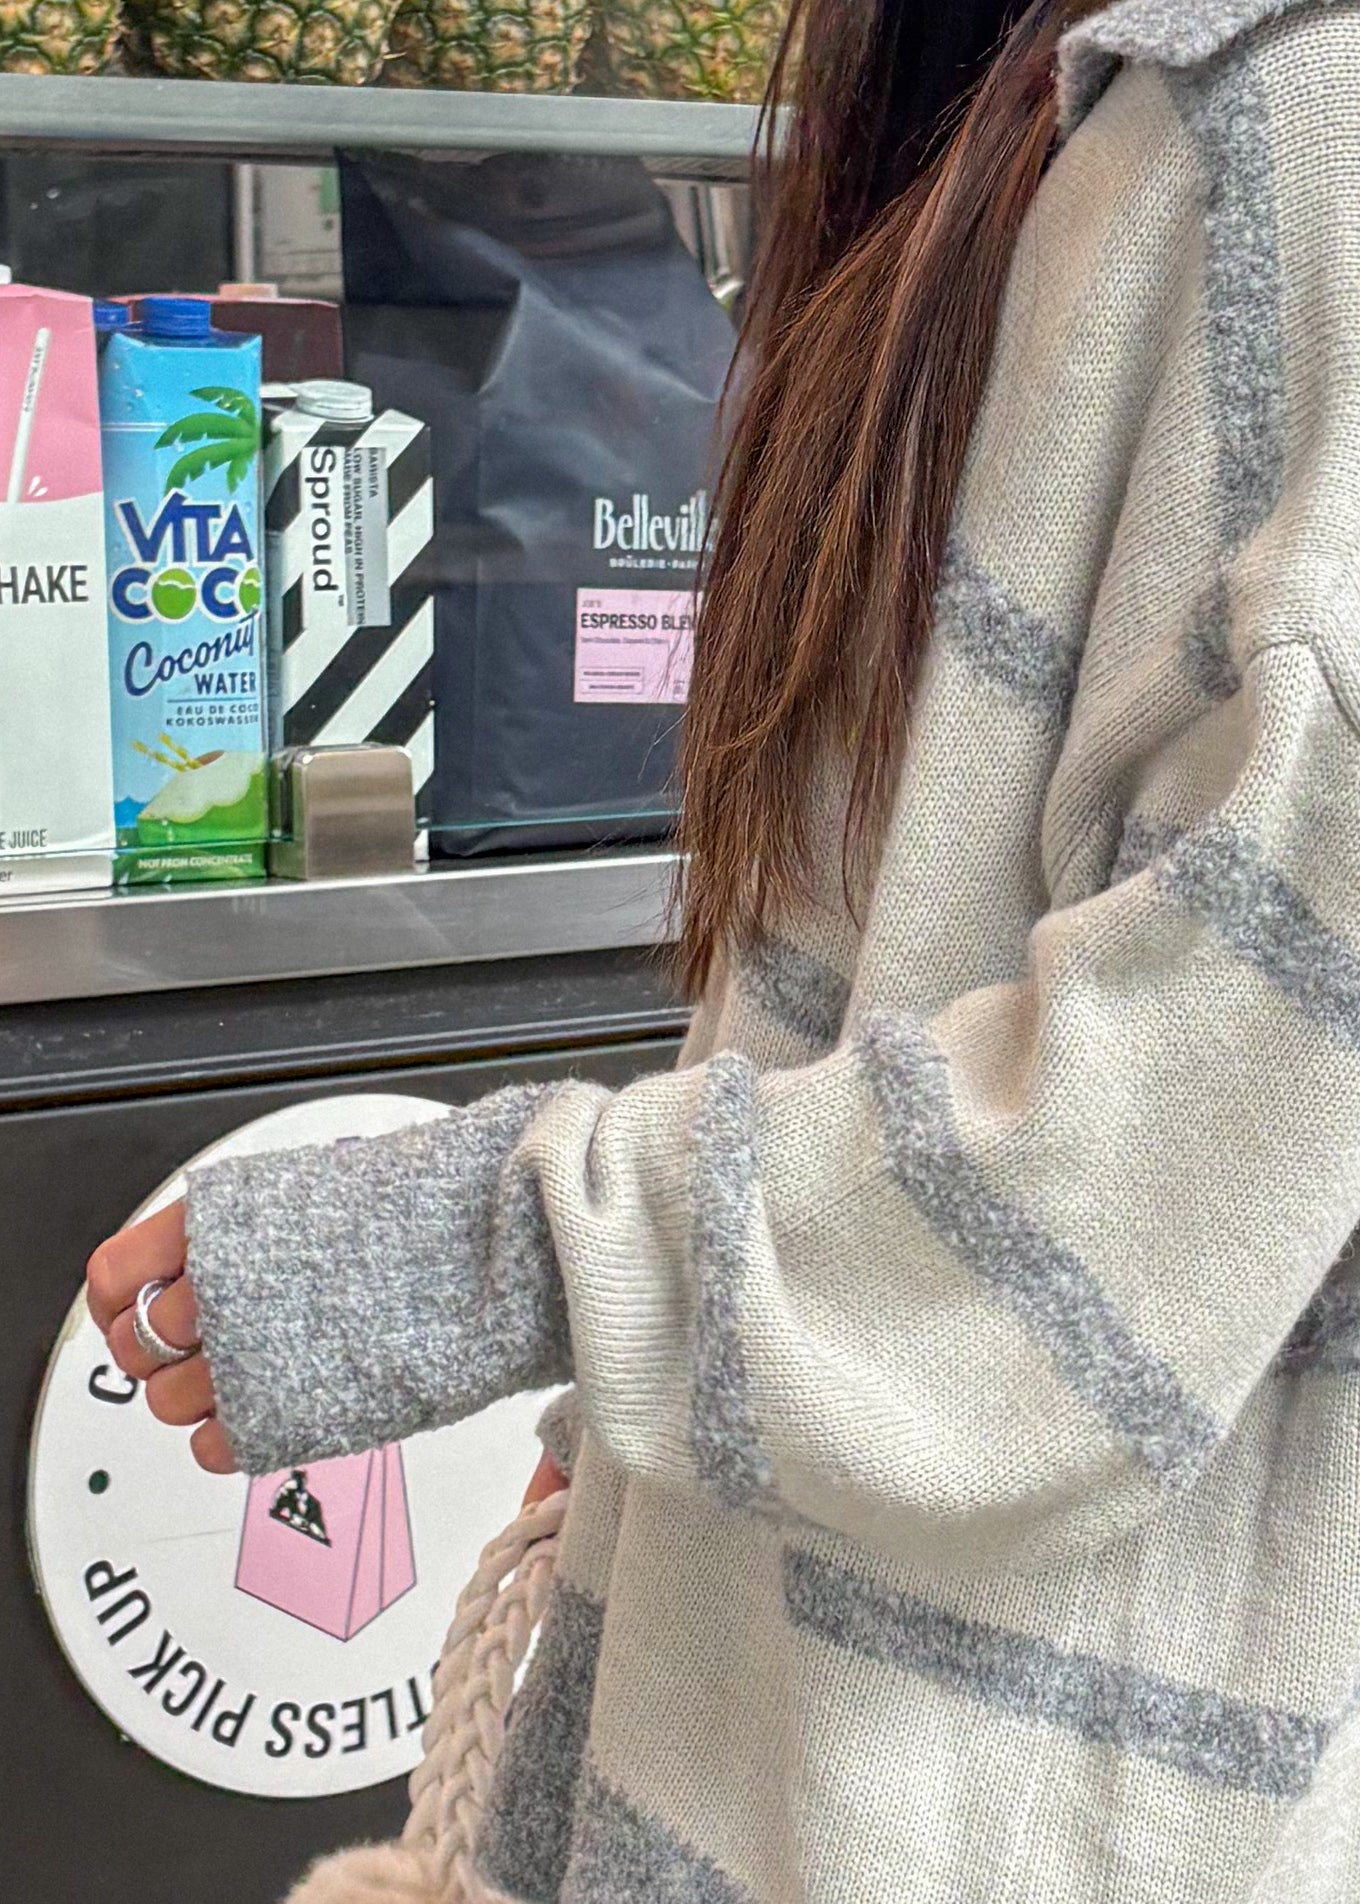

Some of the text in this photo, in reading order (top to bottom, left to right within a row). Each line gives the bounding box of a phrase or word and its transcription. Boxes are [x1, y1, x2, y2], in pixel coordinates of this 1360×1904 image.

[118, 491, 255, 563] VITA
[305, 447, 339, 591] Sproud
[111, 566, 262, 621] COCO
[580, 612, 658, 631] ESPRESSO
[124, 607, 260, 697] Coconut
[194, 671, 258, 695] WATER
[8, 829, 49, 849] JUICE
[83, 1558, 152, 1645] UP
[128, 1627, 260, 1747] PICK
